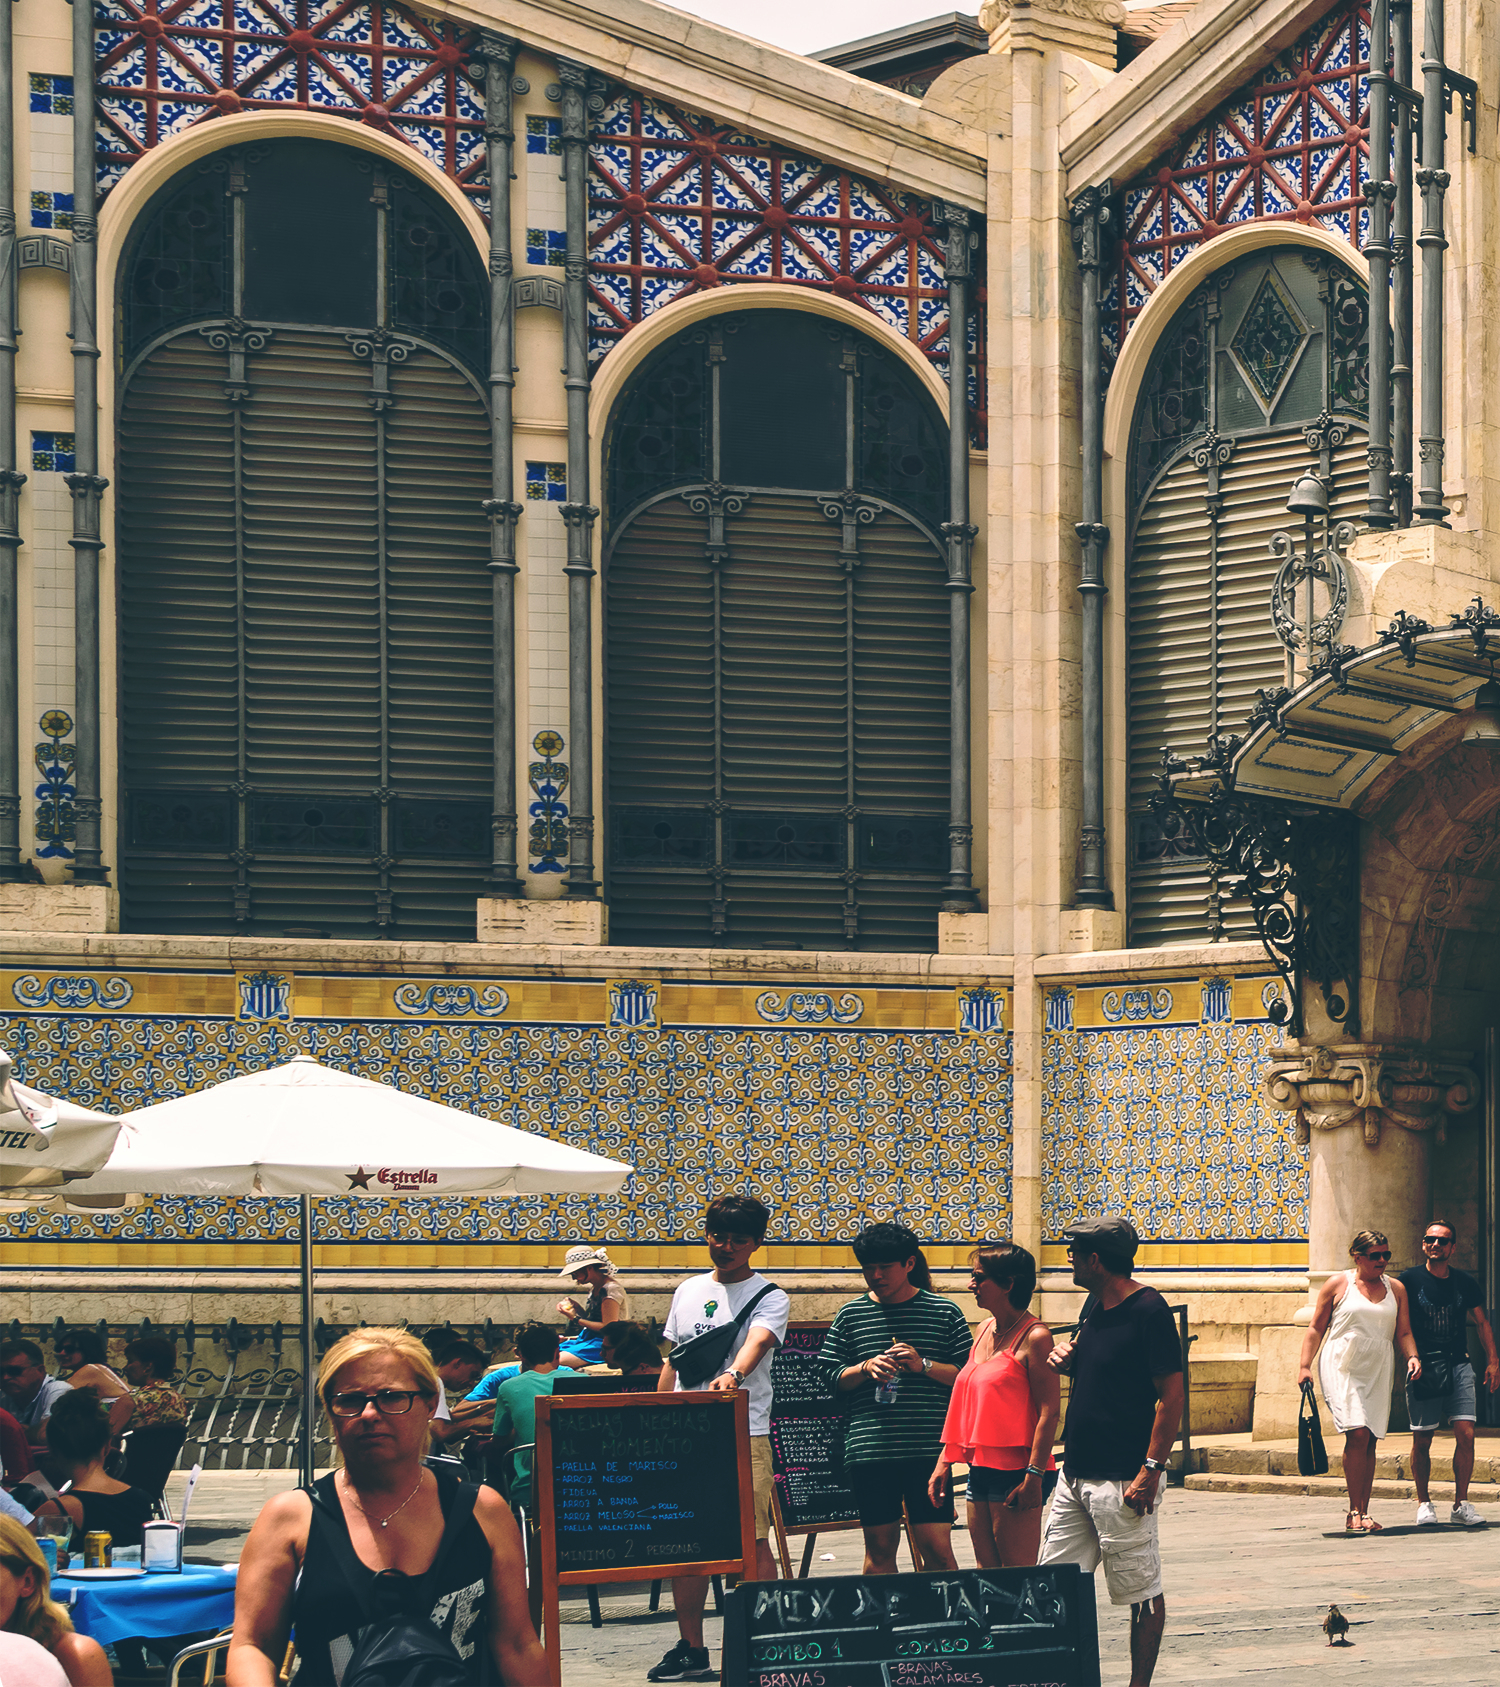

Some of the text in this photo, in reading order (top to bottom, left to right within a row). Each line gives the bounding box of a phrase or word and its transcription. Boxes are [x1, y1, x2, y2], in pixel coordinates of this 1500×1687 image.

[377, 1167, 438, 1184] Estrella
[555, 1410, 710, 1438] PAELLAS HECHAS
[560, 1433, 692, 1457] AL MOMENTO
[606, 1462, 618, 1471] DE
[629, 1461, 677, 1470] MARISCO
[602, 1475, 633, 1483] NEGRO
[610, 1497, 639, 1506] BANDA
[658, 1502, 678, 1510] POLLO
[598, 1510, 635, 1520] MELOSO
[659, 1511, 694, 1520] MARISCO
[561, 1539, 700, 1561] MINIMO 2 PERSONAS
[753, 1582, 836, 1629] MIX
[753, 1637, 843, 1661] COMBO 1
[895, 1634, 995, 1656] COMBO 2
